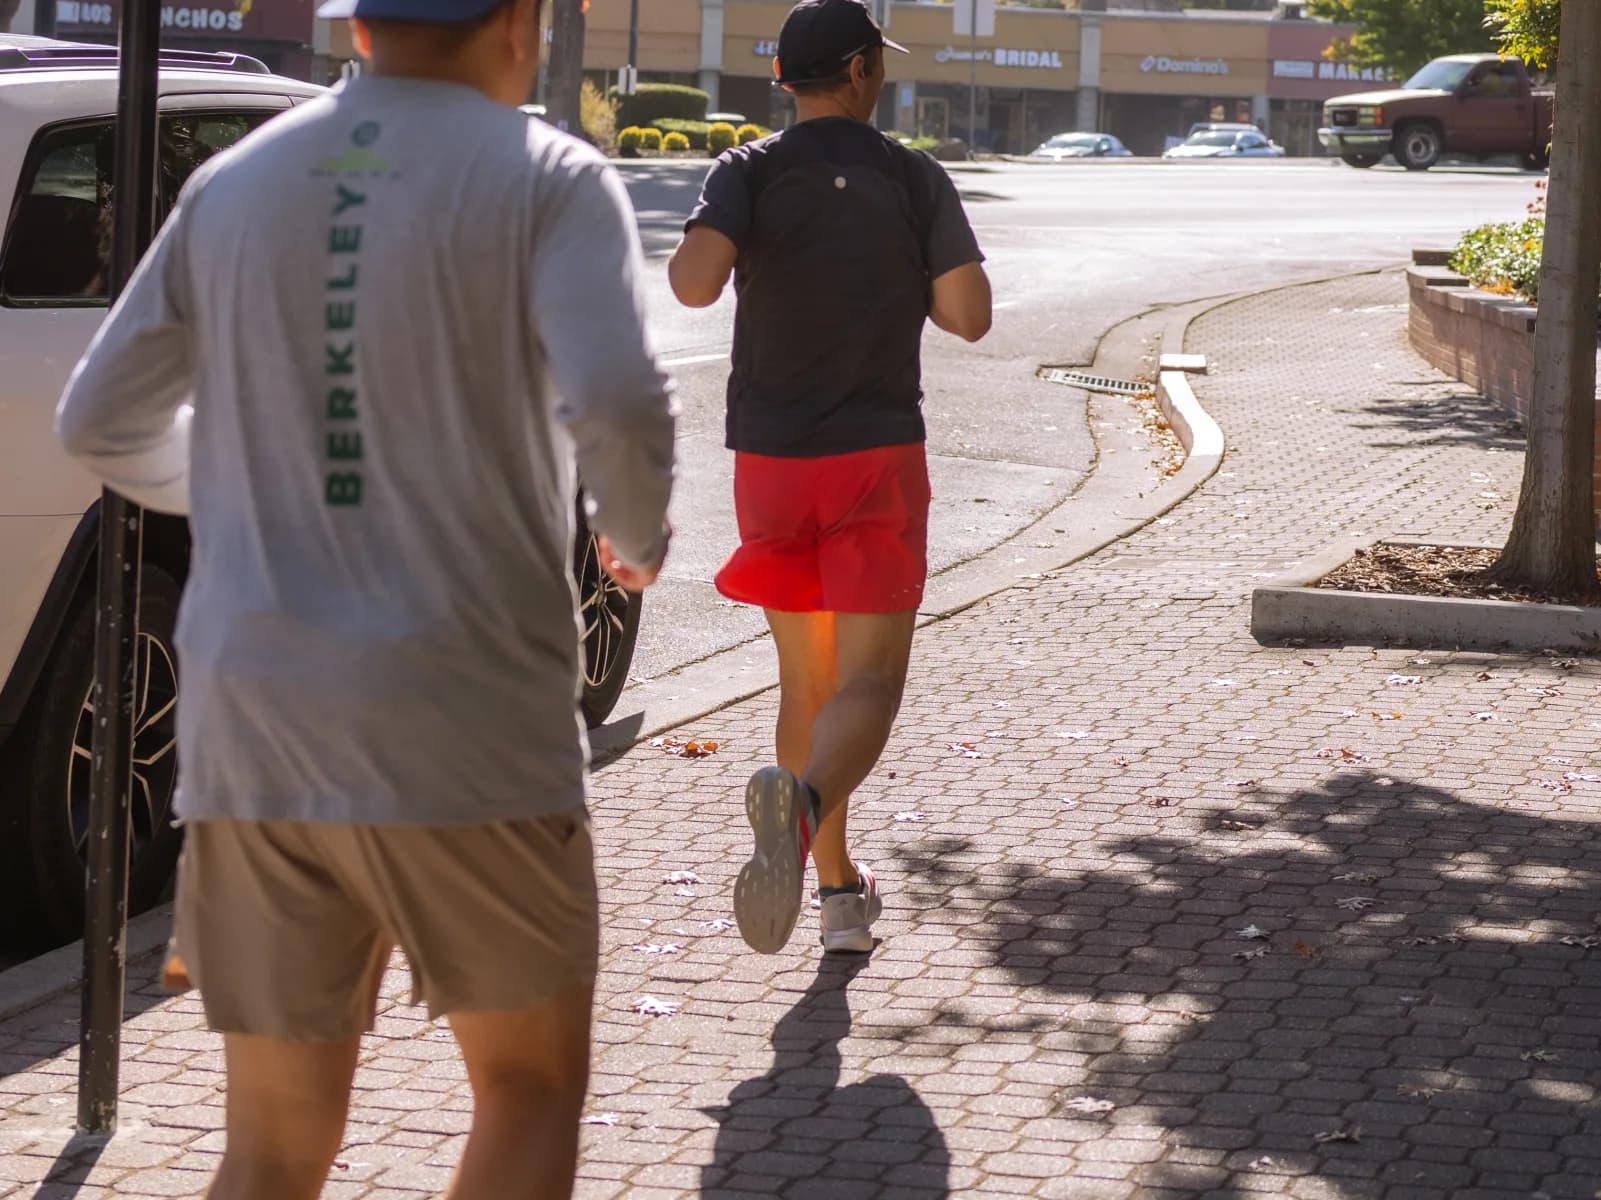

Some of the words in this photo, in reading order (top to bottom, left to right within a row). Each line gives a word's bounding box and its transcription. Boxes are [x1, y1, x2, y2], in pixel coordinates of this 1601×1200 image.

[81, 3, 112, 25] LOS
[161, 6, 243, 31] NCHOS
[994, 48, 1062, 68] BRIDAL
[325, 183, 367, 506] BERKELEY
